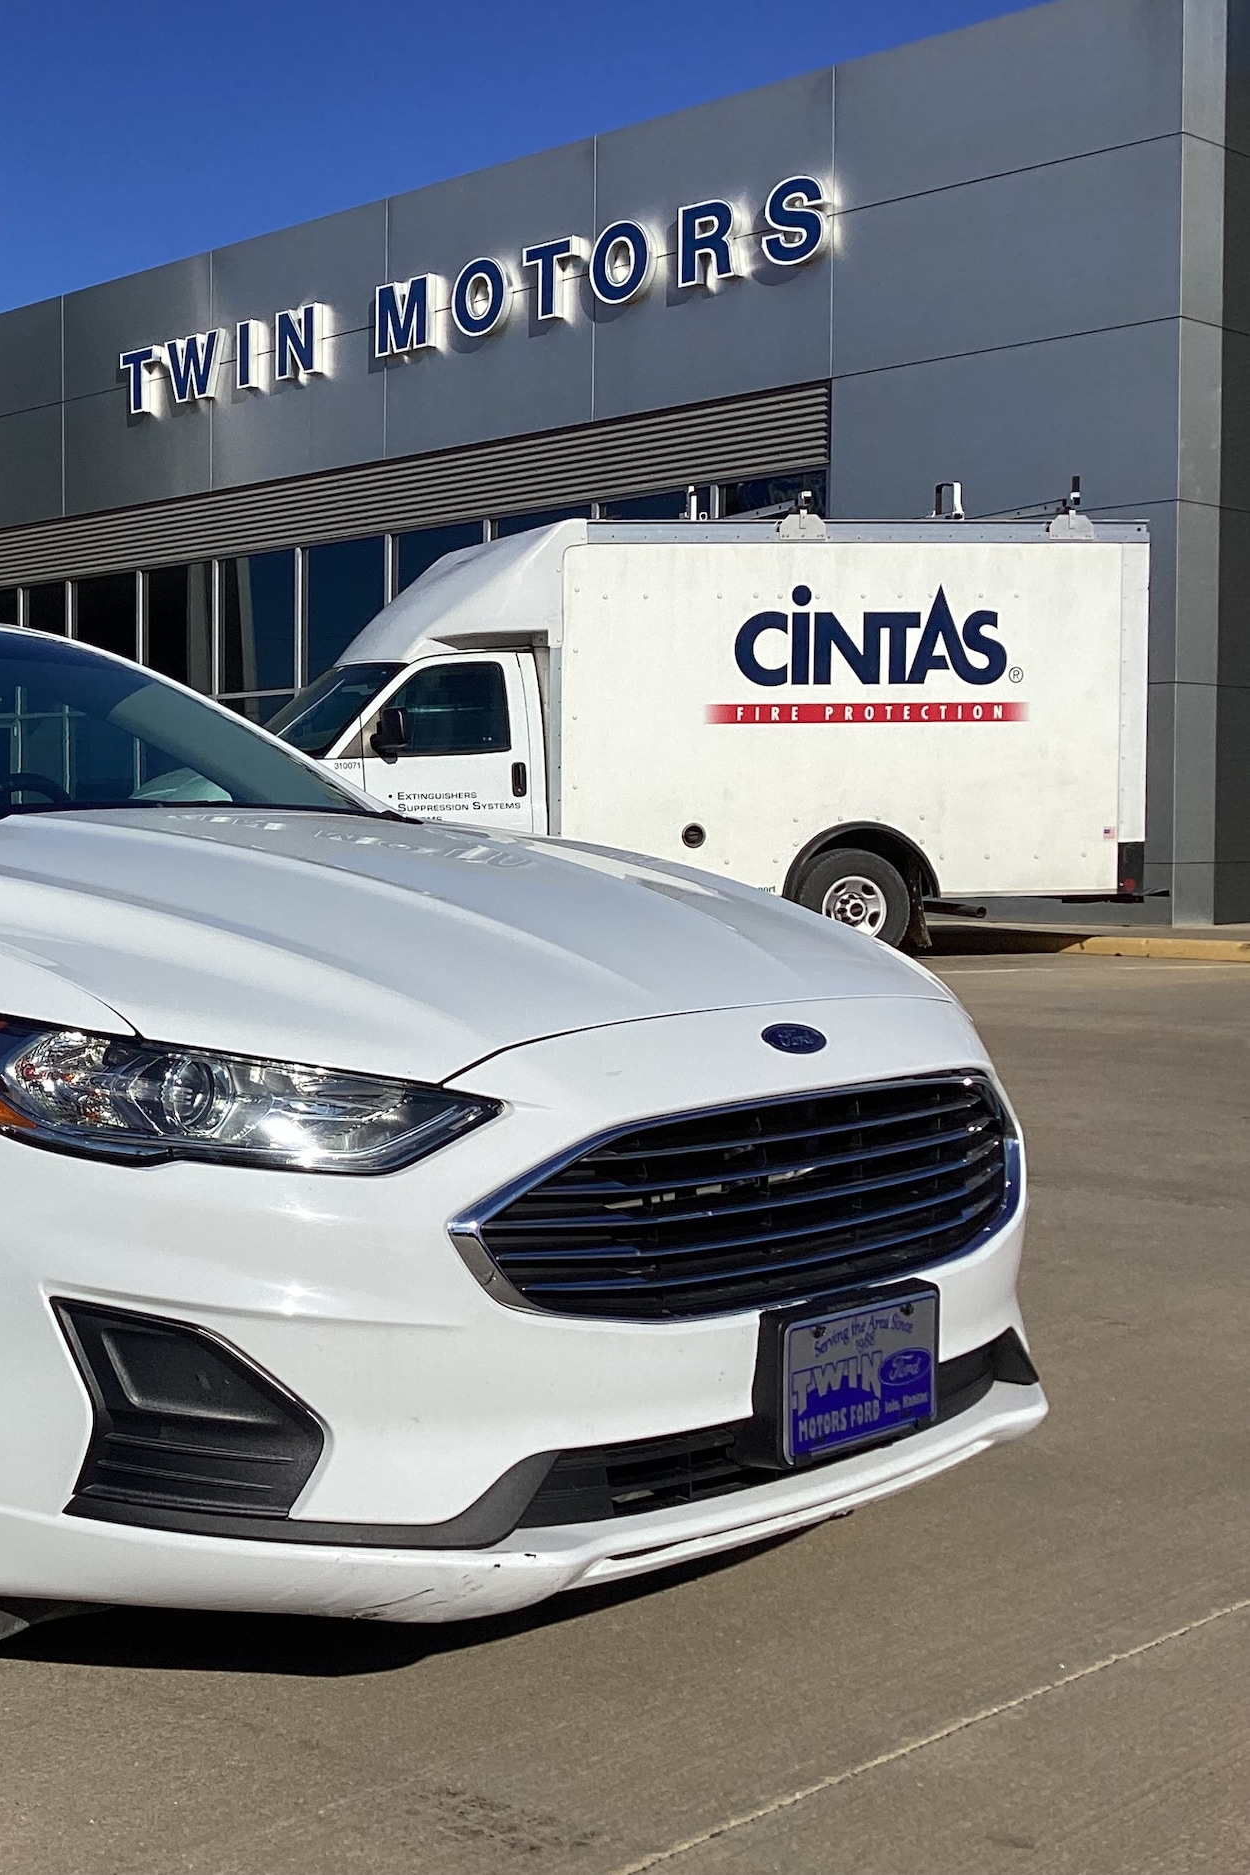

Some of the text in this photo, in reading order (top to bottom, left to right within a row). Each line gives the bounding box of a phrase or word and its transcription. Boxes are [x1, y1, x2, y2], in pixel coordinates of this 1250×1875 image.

[119, 173, 835, 414] TWIN MOTORS
[736, 703, 1004, 723] FIRE PROTECTION
[333, 761, 362, 770] 310071
[397, 791, 478, 801] EXTINGUISHERS
[398, 801, 521, 812] SUPPRESSION SYSTEMS
[814, 1327, 849, 1358] Serving
[851, 1316, 866, 1336] the
[869, 1314, 889, 1331] Area
[889, 1354, 922, 1381] Ford
[792, 1351, 882, 1416] TWIN
[797, 1399, 881, 1443] MOTORS FORD
